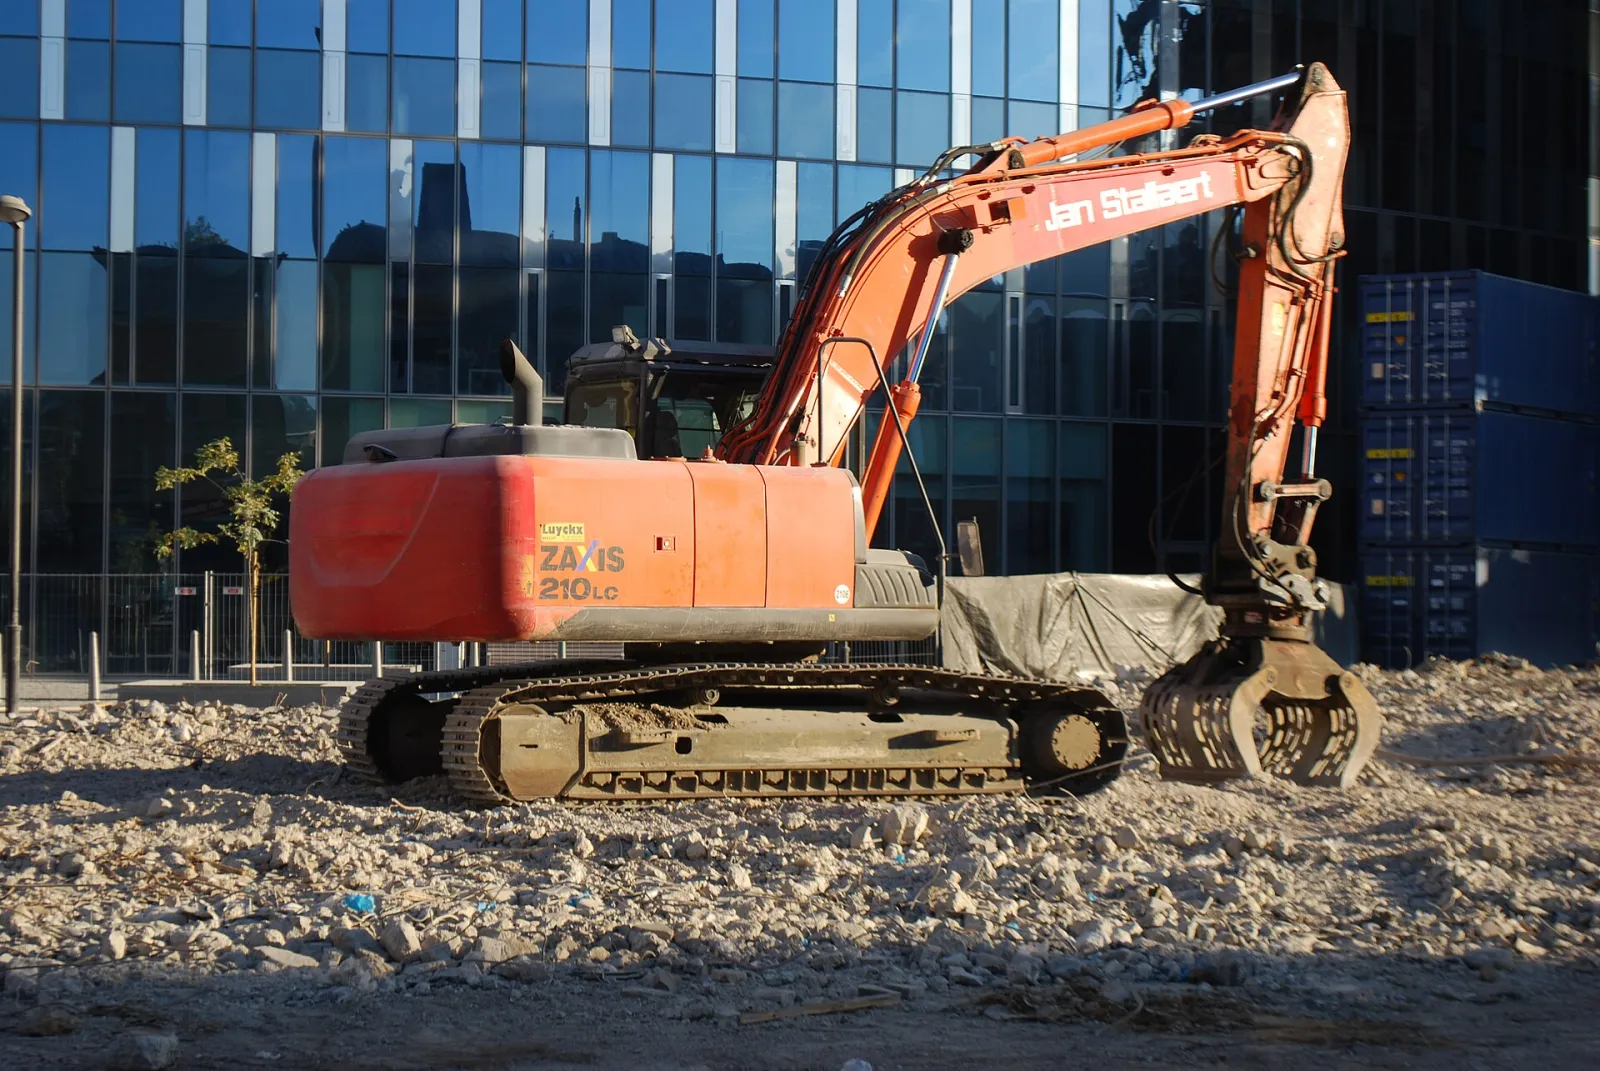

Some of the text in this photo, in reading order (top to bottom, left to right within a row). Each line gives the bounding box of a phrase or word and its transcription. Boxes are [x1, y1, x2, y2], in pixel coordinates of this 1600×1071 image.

[1045, 170, 1213, 231] Jan Stallaert
[542, 524, 583, 536] Luyckx
[540, 540, 625, 572] ZAXIS
